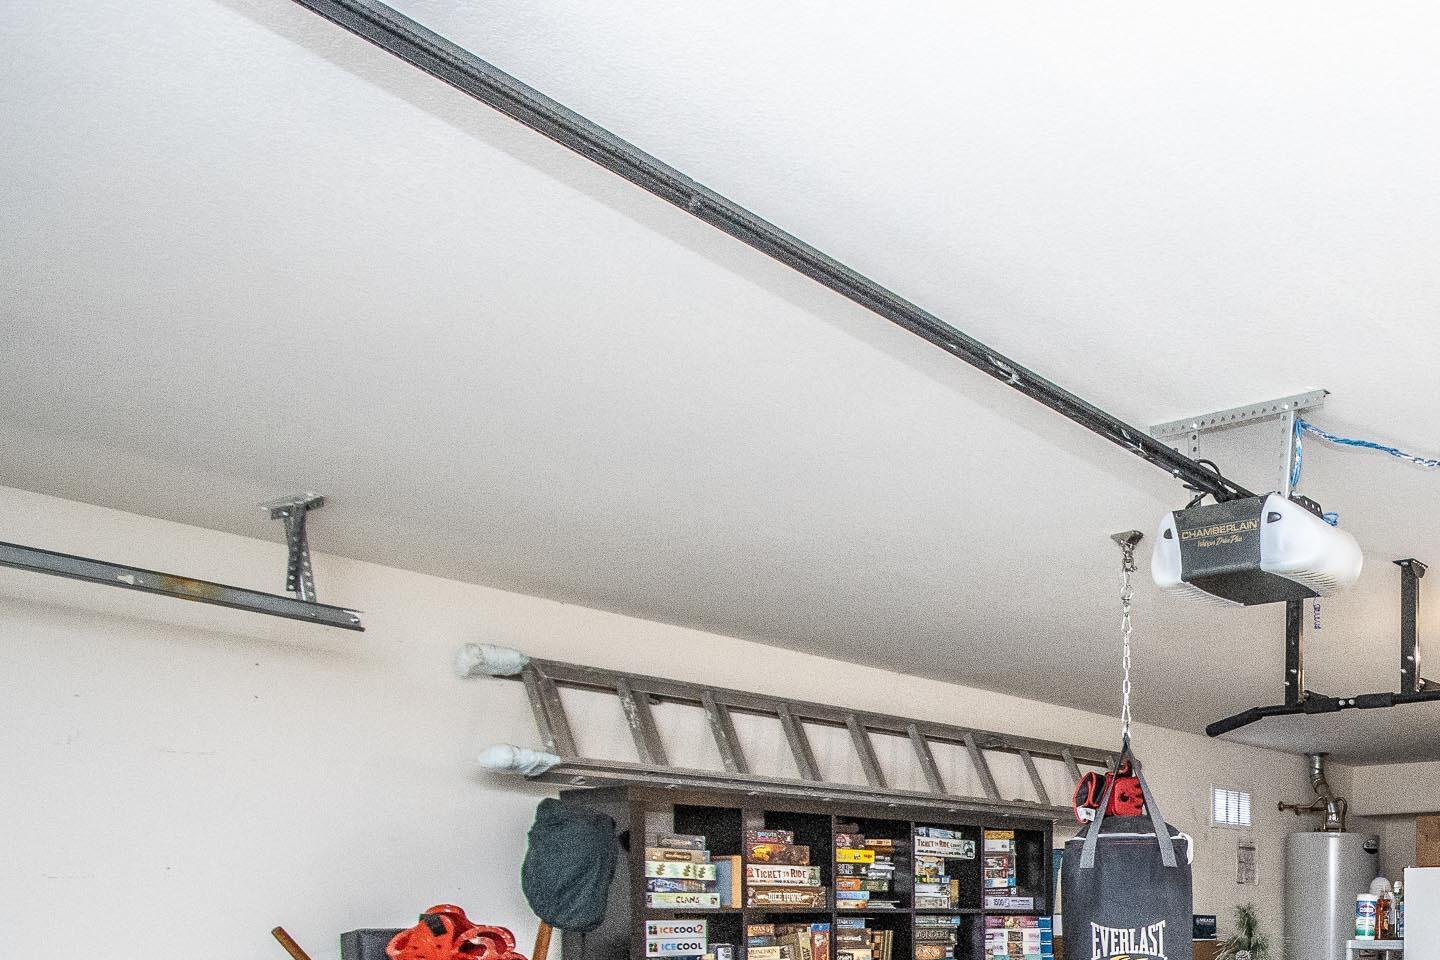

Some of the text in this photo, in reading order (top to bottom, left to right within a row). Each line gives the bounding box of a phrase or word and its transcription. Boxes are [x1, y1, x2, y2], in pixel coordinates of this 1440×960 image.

[1181, 520, 1258, 540] CHAMBERLAIN
[754, 867, 781, 879] TICKET
[790, 868, 807, 879] RIDE
[675, 895, 700, 904] CLANS
[661, 942, 703, 951] ICECOOL
